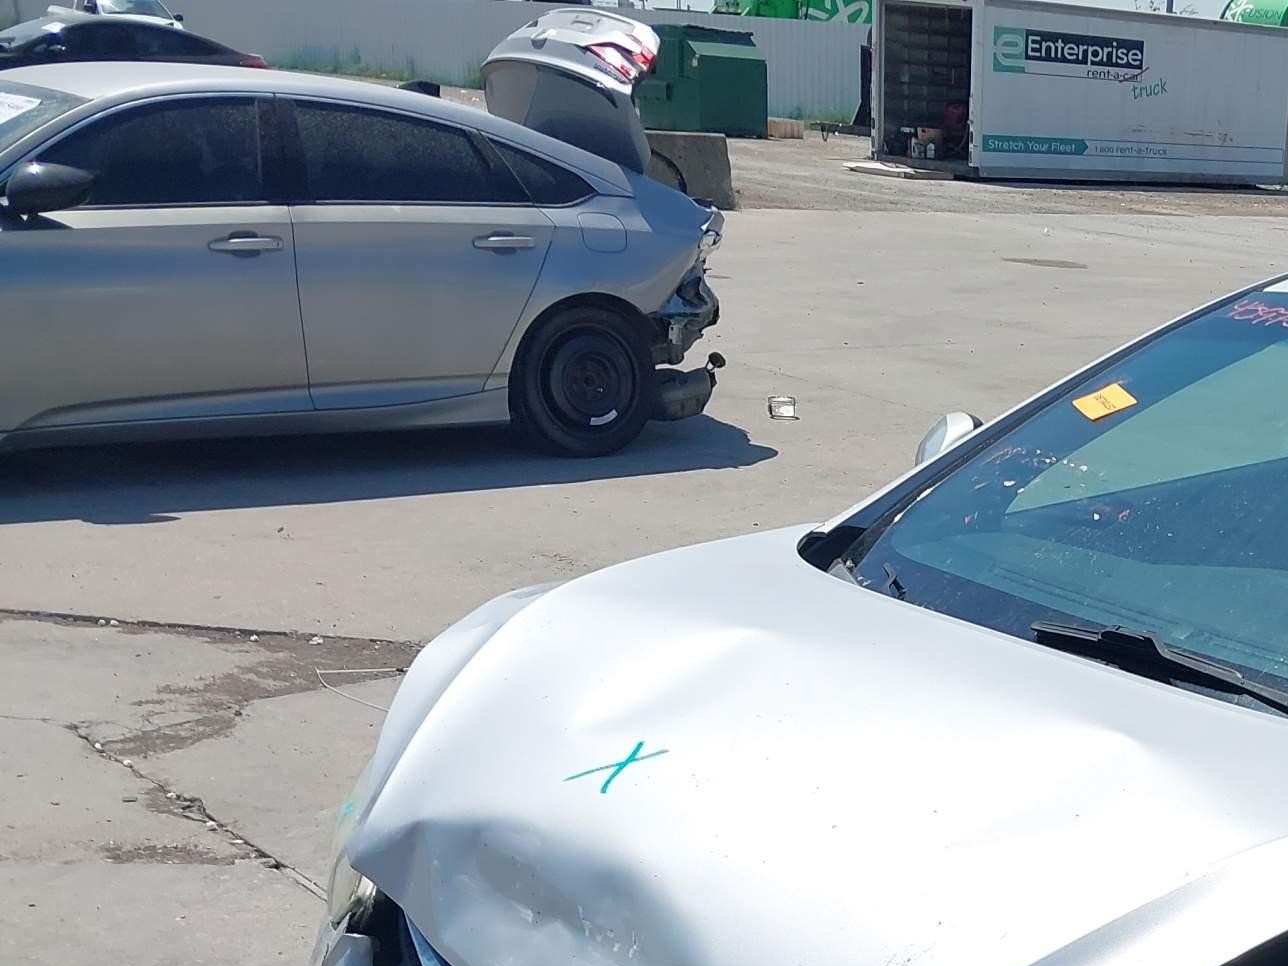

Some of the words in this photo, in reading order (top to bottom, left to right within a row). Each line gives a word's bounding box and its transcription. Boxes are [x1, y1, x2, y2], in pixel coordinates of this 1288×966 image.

[1027, 35, 1142, 67] Enterprise
[1087, 69, 1140, 81] rent-a-car
[1132, 78, 1168, 99] truck
[988, 139, 1025, 151] Stretch
[1027, 141, 1049, 151] Your
[1051, 143, 1076, 153] Fleet
